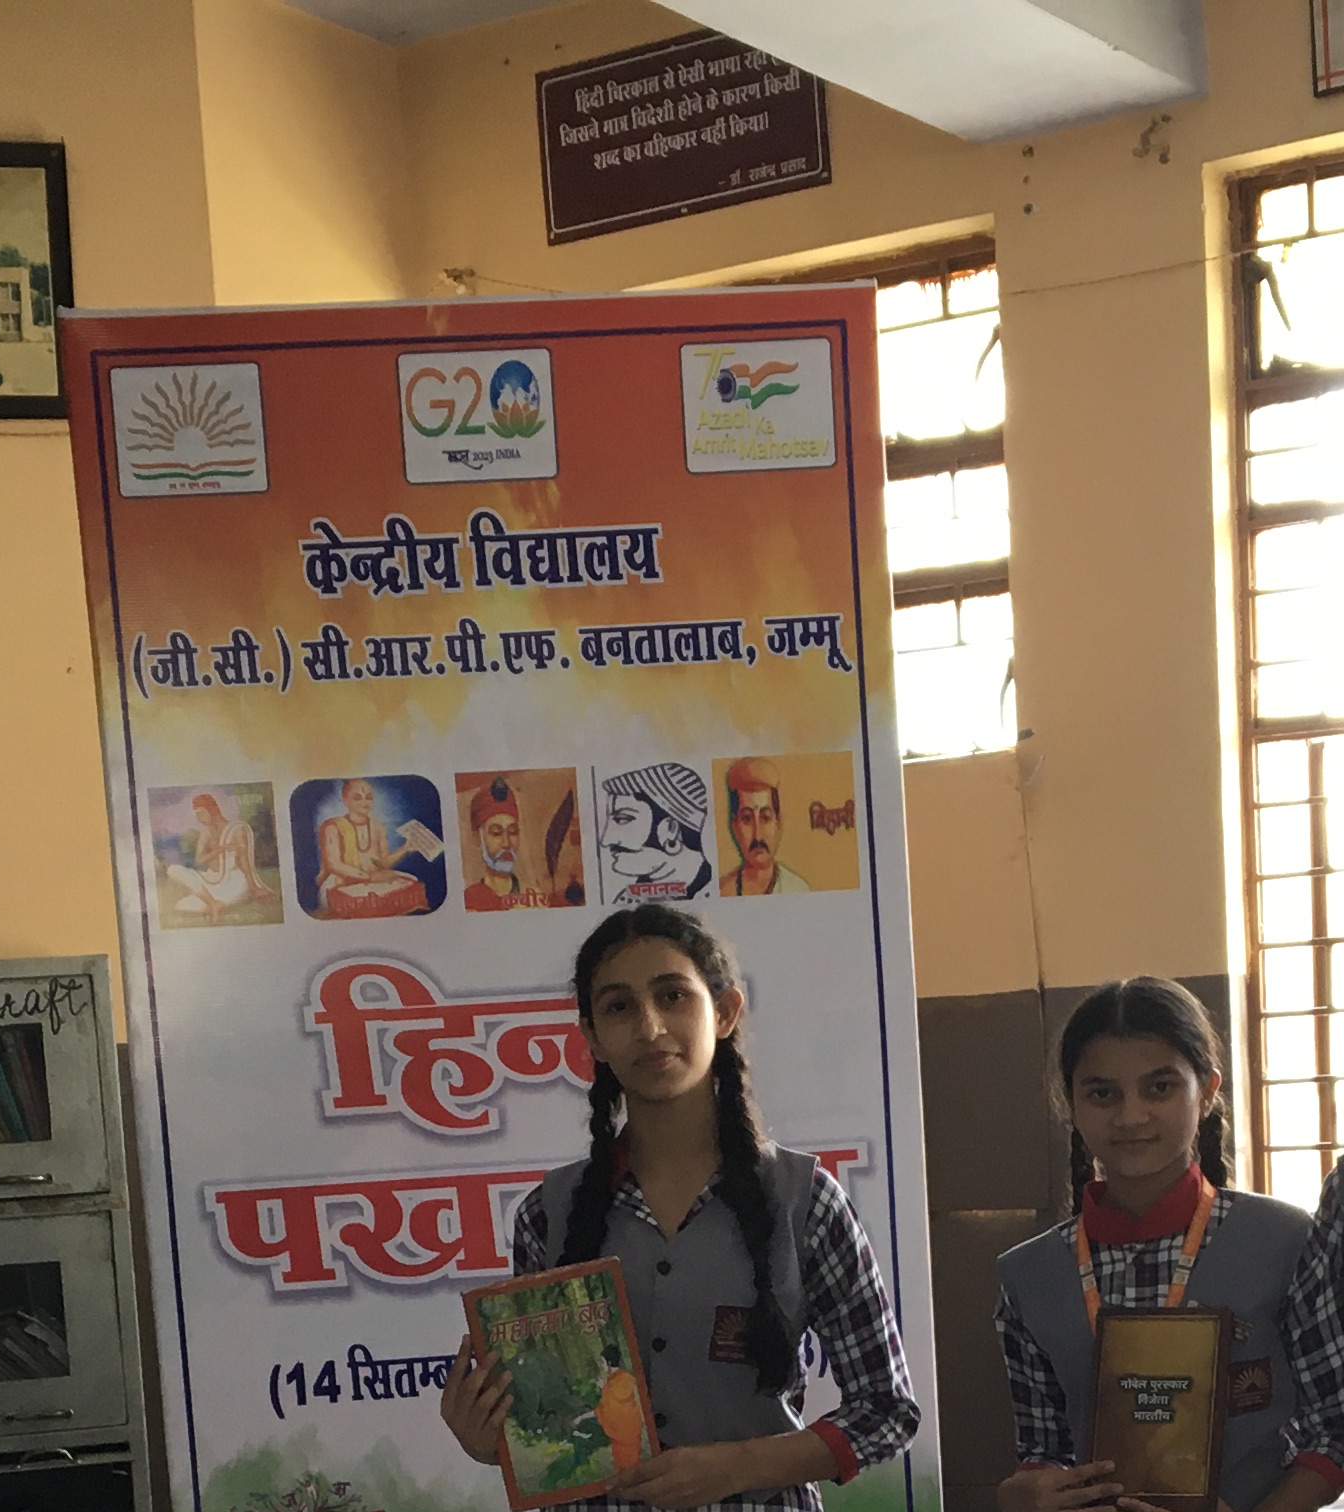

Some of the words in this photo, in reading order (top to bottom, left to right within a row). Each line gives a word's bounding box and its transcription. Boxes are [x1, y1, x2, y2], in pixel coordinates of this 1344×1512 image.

[575, 85, 605, 114] हिंदी
[663, 66, 675, 89] से
[678, 59, 705, 87] ऐसी
[708, 55, 741, 77] भाषा
[559, 117, 600, 146] जिसने
[631, 98, 674, 129] विदेशी
[678, 91, 703, 121] होने
[706, 87, 719, 110] के
[722, 82, 761, 106] कारण
[764, 67, 800, 97] किसी
[593, 148, 621, 170] शब्द
[623, 143, 641, 162] का
[700, 116, 727, 145] नहीं
[697, 406, 751, 430] Azadi
[495, 449, 521, 460] INDIA
[692, 432, 737, 454] Amrit
[737, 437, 830, 461] Mahotsav
[301, 516, 461, 596] केन्द्रीय
[469, 511, 660, 588] विद्यालय
[764, 615, 853, 672] जम्मू
[269, 1359, 341, 1420] (14
[346, 1343, 477, 1401] सितम्ब
[1119, 1376, 1147, 1390] नोबेल
[1149, 1379, 1190, 1393] पुरस्कार
[1137, 1393, 1170, 1406] विजेता
[1133, 1408, 1172, 1422] भारतीय
